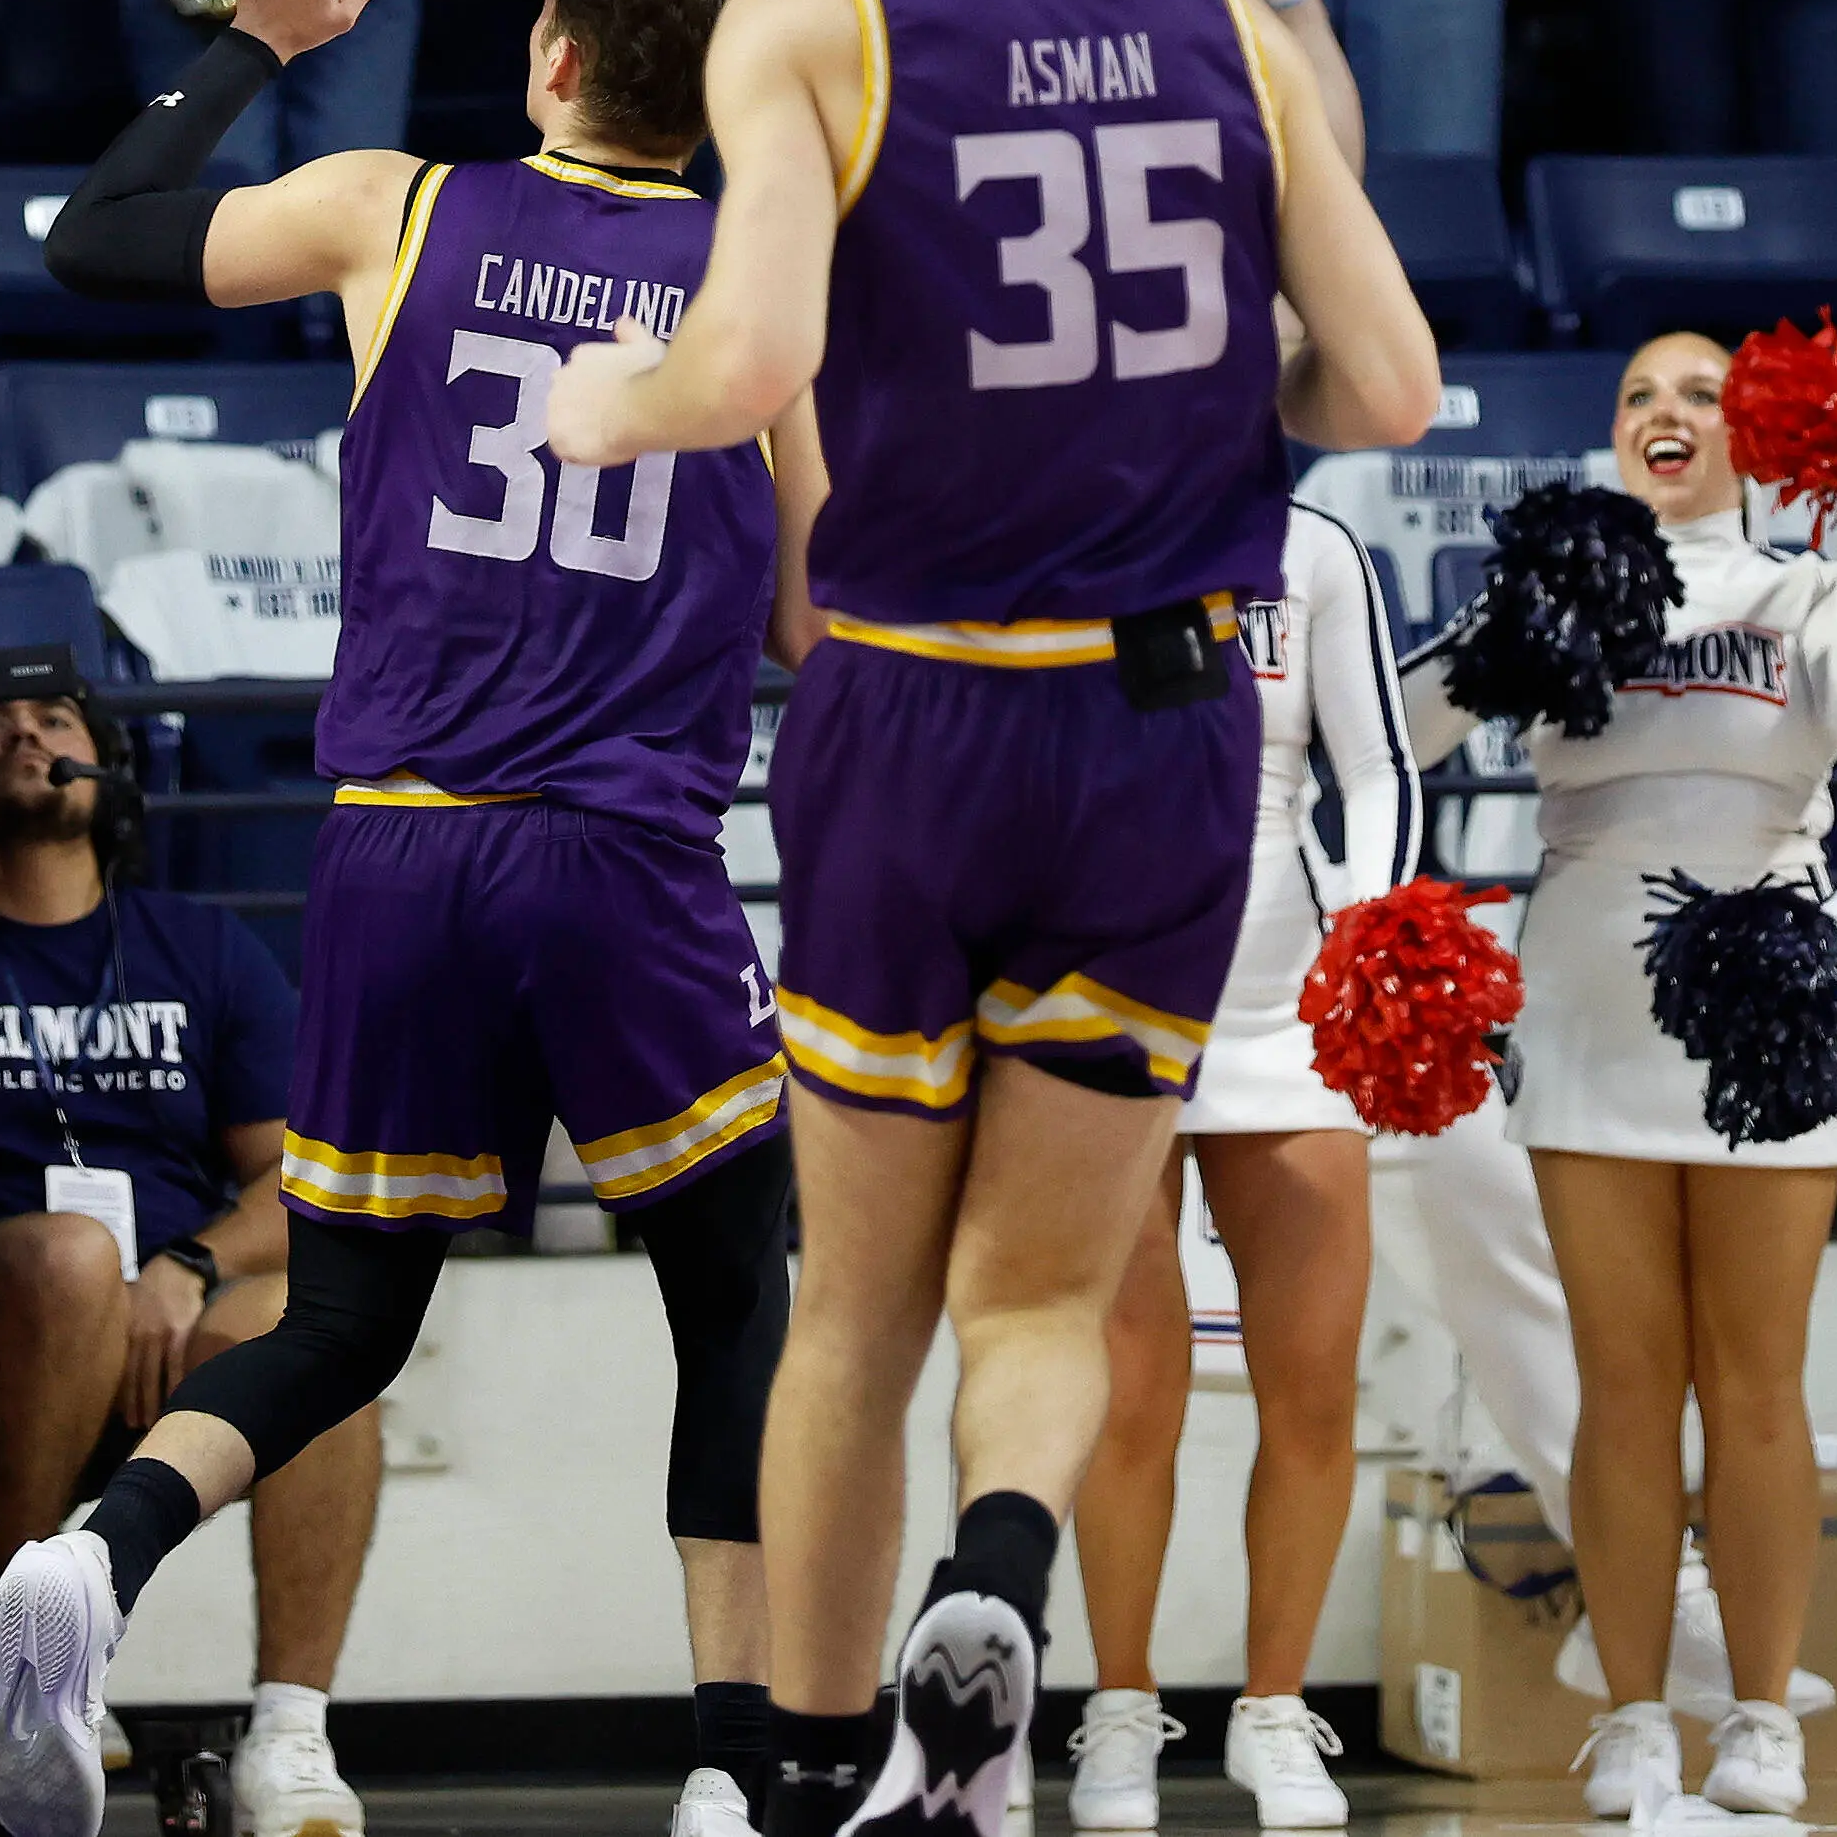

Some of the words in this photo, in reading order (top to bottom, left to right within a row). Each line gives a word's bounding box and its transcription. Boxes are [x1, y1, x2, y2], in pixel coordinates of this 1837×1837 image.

[1008, 32, 1156, 107] ASMAN
[474, 252, 686, 341] CANDELINO
[953, 118, 1228, 391] 35
[426, 329, 678, 582] 30
